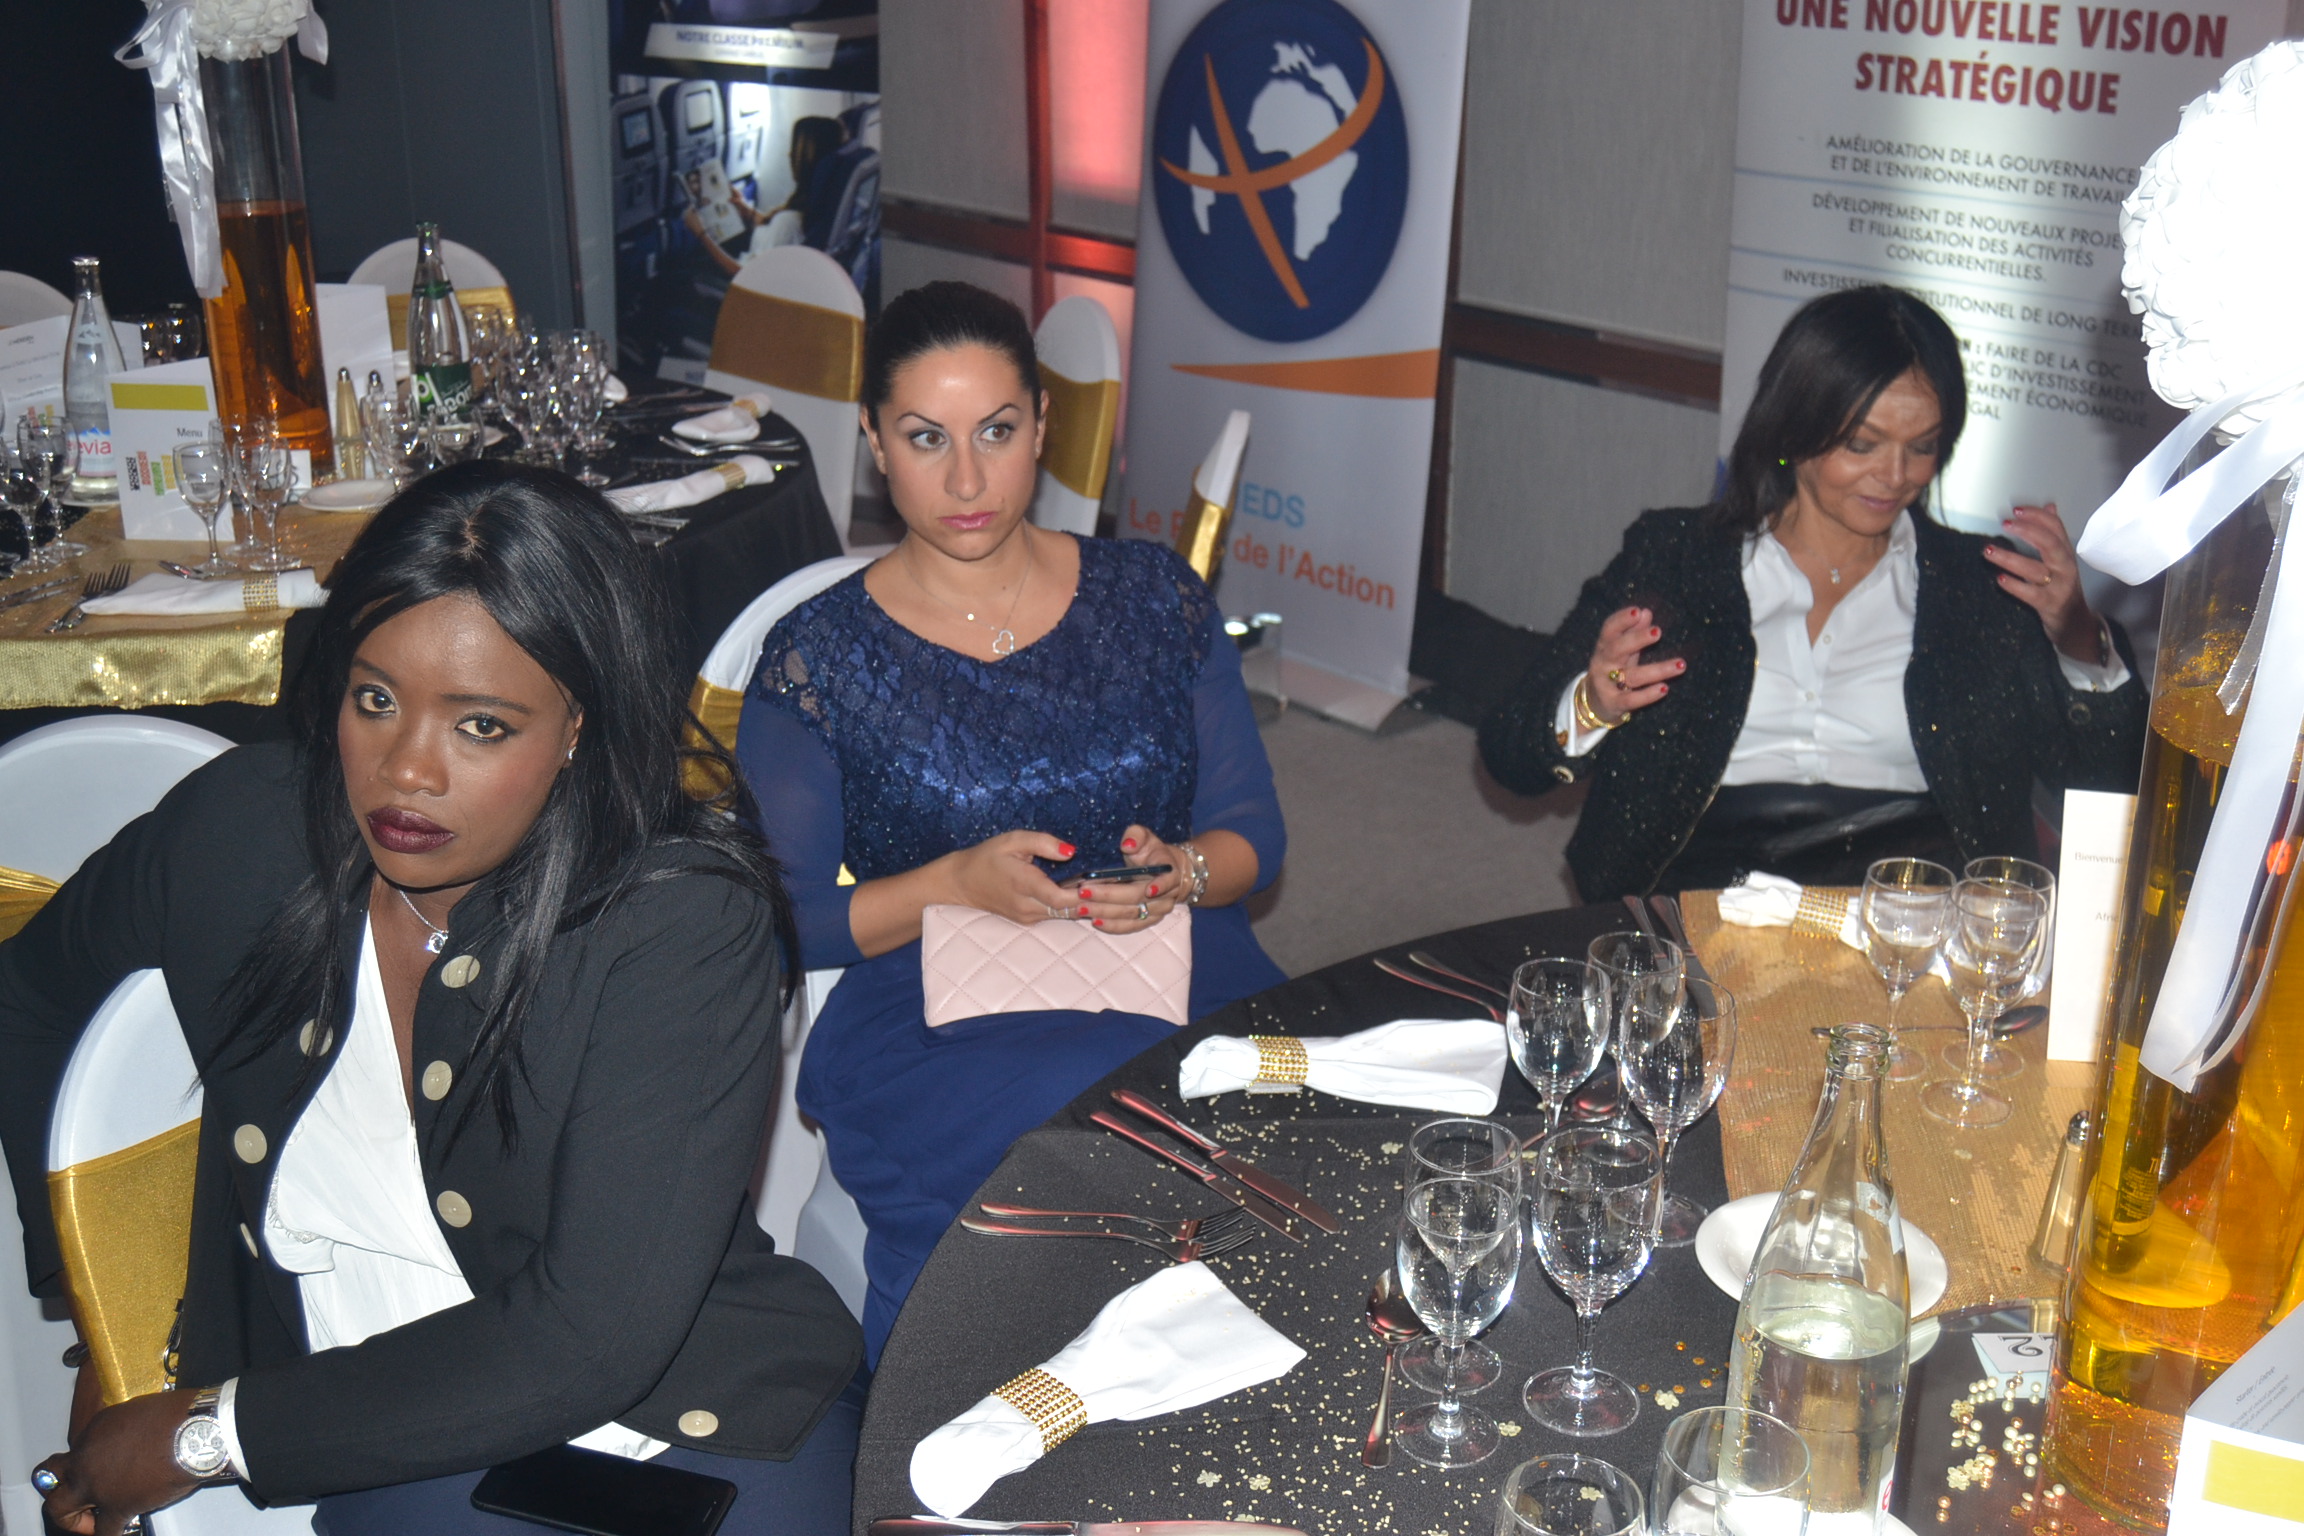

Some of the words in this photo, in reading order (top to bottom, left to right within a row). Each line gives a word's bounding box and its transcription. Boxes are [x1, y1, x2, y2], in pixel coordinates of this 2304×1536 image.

[1776, 0, 1849, 29] UNE
[1864, 0, 2061, 45] NOUVELLE
[2077, 6, 2228, 58] VISION
[1855, 50, 2121, 116] STRATÉGIQUE
[1826, 133, 1945, 163] AMÉLIORATION
[1950, 147, 1971, 166] DE
[1975, 152, 1994, 168] LA
[2000, 154, 2137, 186] GOUVERNANCE
[1831, 155, 1847, 171] ET
[1852, 157, 1870, 175] DE
[1875, 159, 2029, 193] L'ENVIRONNEMENT
[2034, 180, 2057, 197] DE
[1812, 191, 1941, 223] DÉVELOPPEMENT
[1945, 210, 1966, 227] DE
[1970, 216, 2065, 242] NOUVEAUX
[2070, 227, 2122, 250] PROJE
[1849, 217, 1865, 233] ET
[1869, 219, 1974, 249] FILIALISATION
[1978, 235, 2008, 255] DES
[2013, 242, 2095, 269] ACTIVITÉS
[2020, 305, 2043, 325] DE
[2047, 310, 2098, 334] LONG
[1986, 341, 2031, 364] FAIRE
[2035, 351, 2055, 369] DE
[2061, 355, 2080, 372] LA
[177, 427, 203, 438] Menu
[1241, 482, 1307, 530] EDS
[1128, 497, 1162, 535] Le
[1233, 532, 1269, 570] de
[1277, 543, 1396, 610] l'Action
